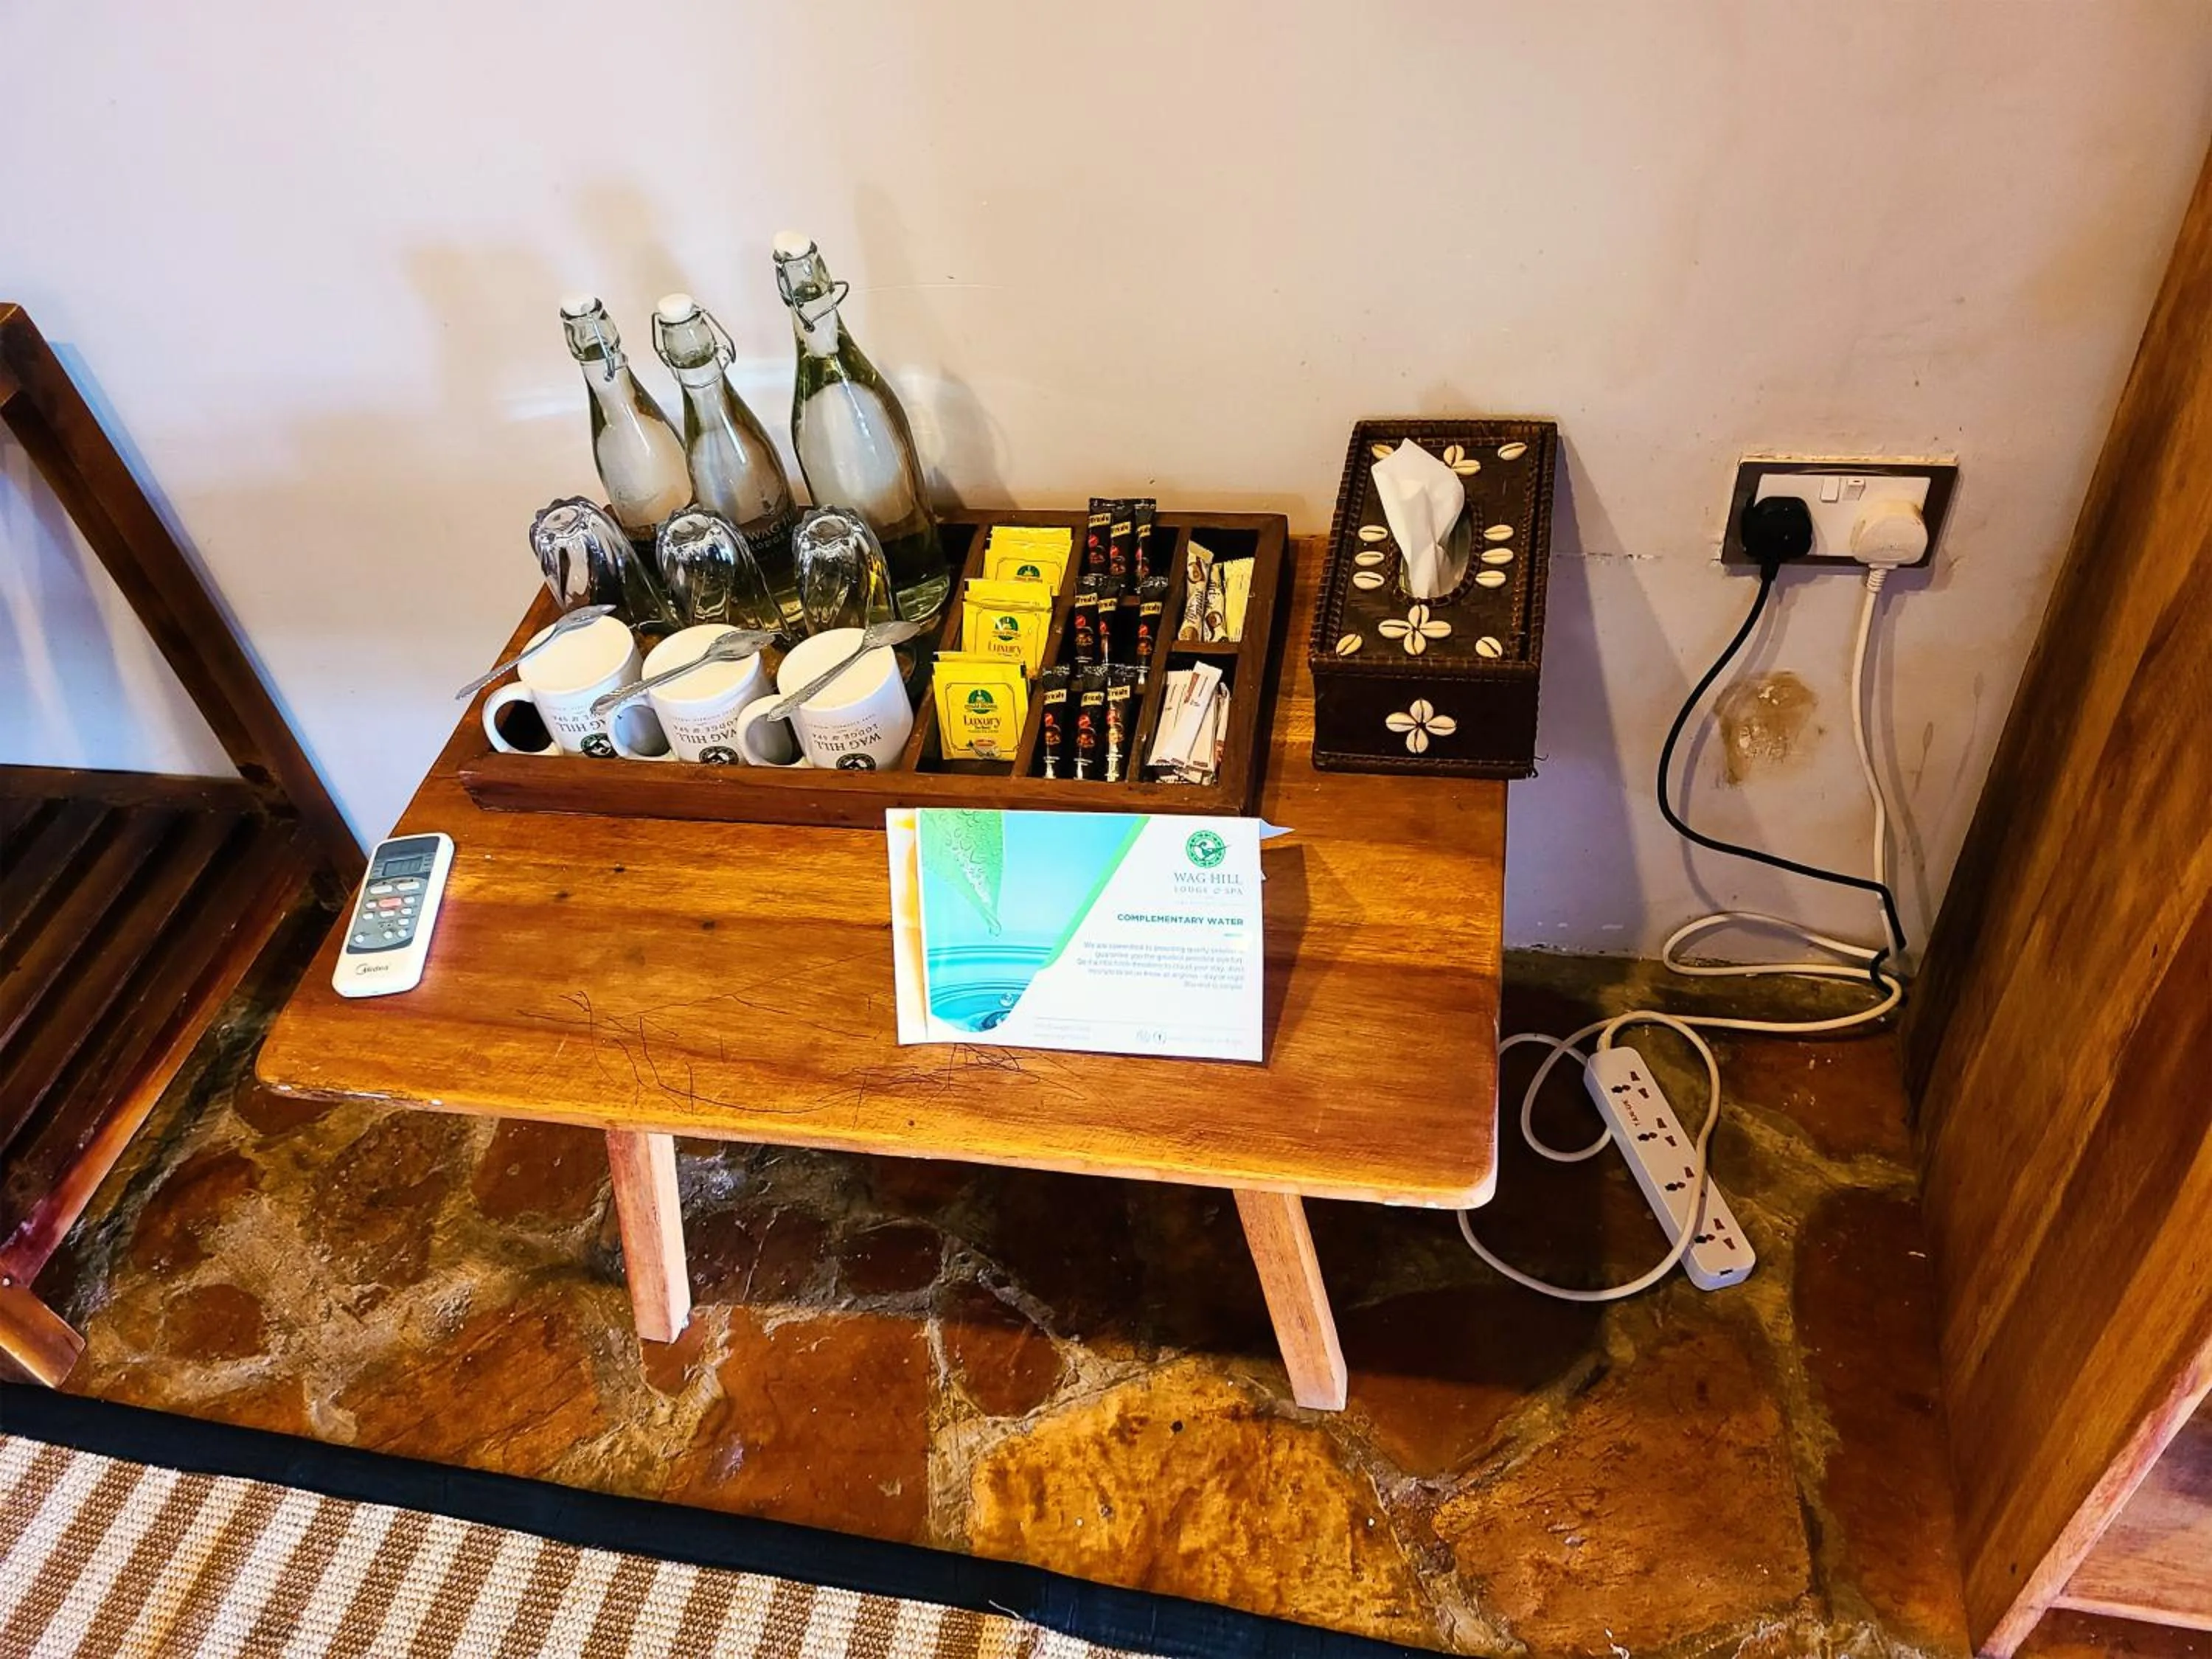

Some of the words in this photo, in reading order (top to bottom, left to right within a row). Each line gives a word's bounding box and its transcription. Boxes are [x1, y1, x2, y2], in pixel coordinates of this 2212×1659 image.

[555, 722, 587, 732] HILL
[964, 714, 1001, 728] Luxury
[843, 723, 879, 740] LODGE
[675, 732, 708, 744] HILL
[849, 732, 882, 750] WAG
[813, 740, 846, 751] HILL
[1174, 872, 1206, 883] WAG
[1210, 873, 1243, 885] HILL
[1117, 914, 1204, 925] COMPLEMENTARY
[1207, 918, 1244, 926] WATER
